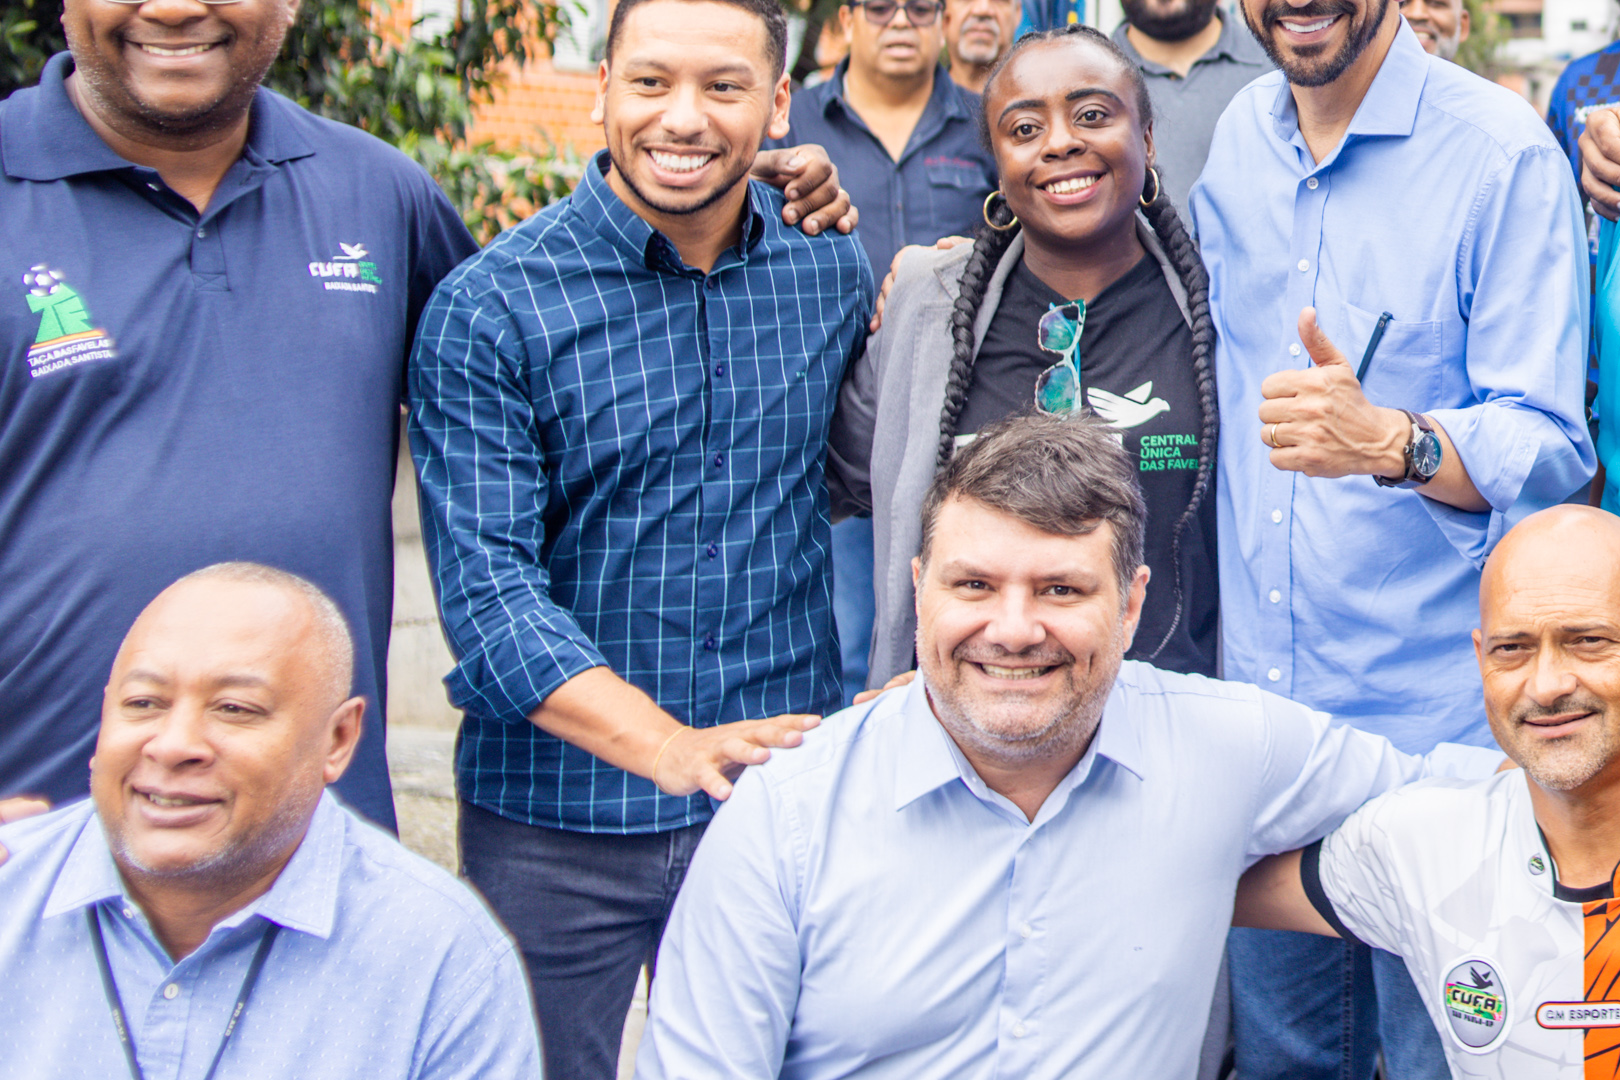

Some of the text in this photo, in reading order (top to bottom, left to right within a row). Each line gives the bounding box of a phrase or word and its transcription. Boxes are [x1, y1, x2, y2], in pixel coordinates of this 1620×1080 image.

[308, 262, 359, 278] CUFA
[31, 350, 113, 378] BAIXADA SANTISTA
[1140, 434, 1198, 446] CENTRAL
[1140, 445, 1182, 459] ÚNICA
[1140, 459, 1165, 471] DAS
[1452, 989, 1497, 1010] CUFA
[1569, 1008, 1620, 1020] ESPORTE
